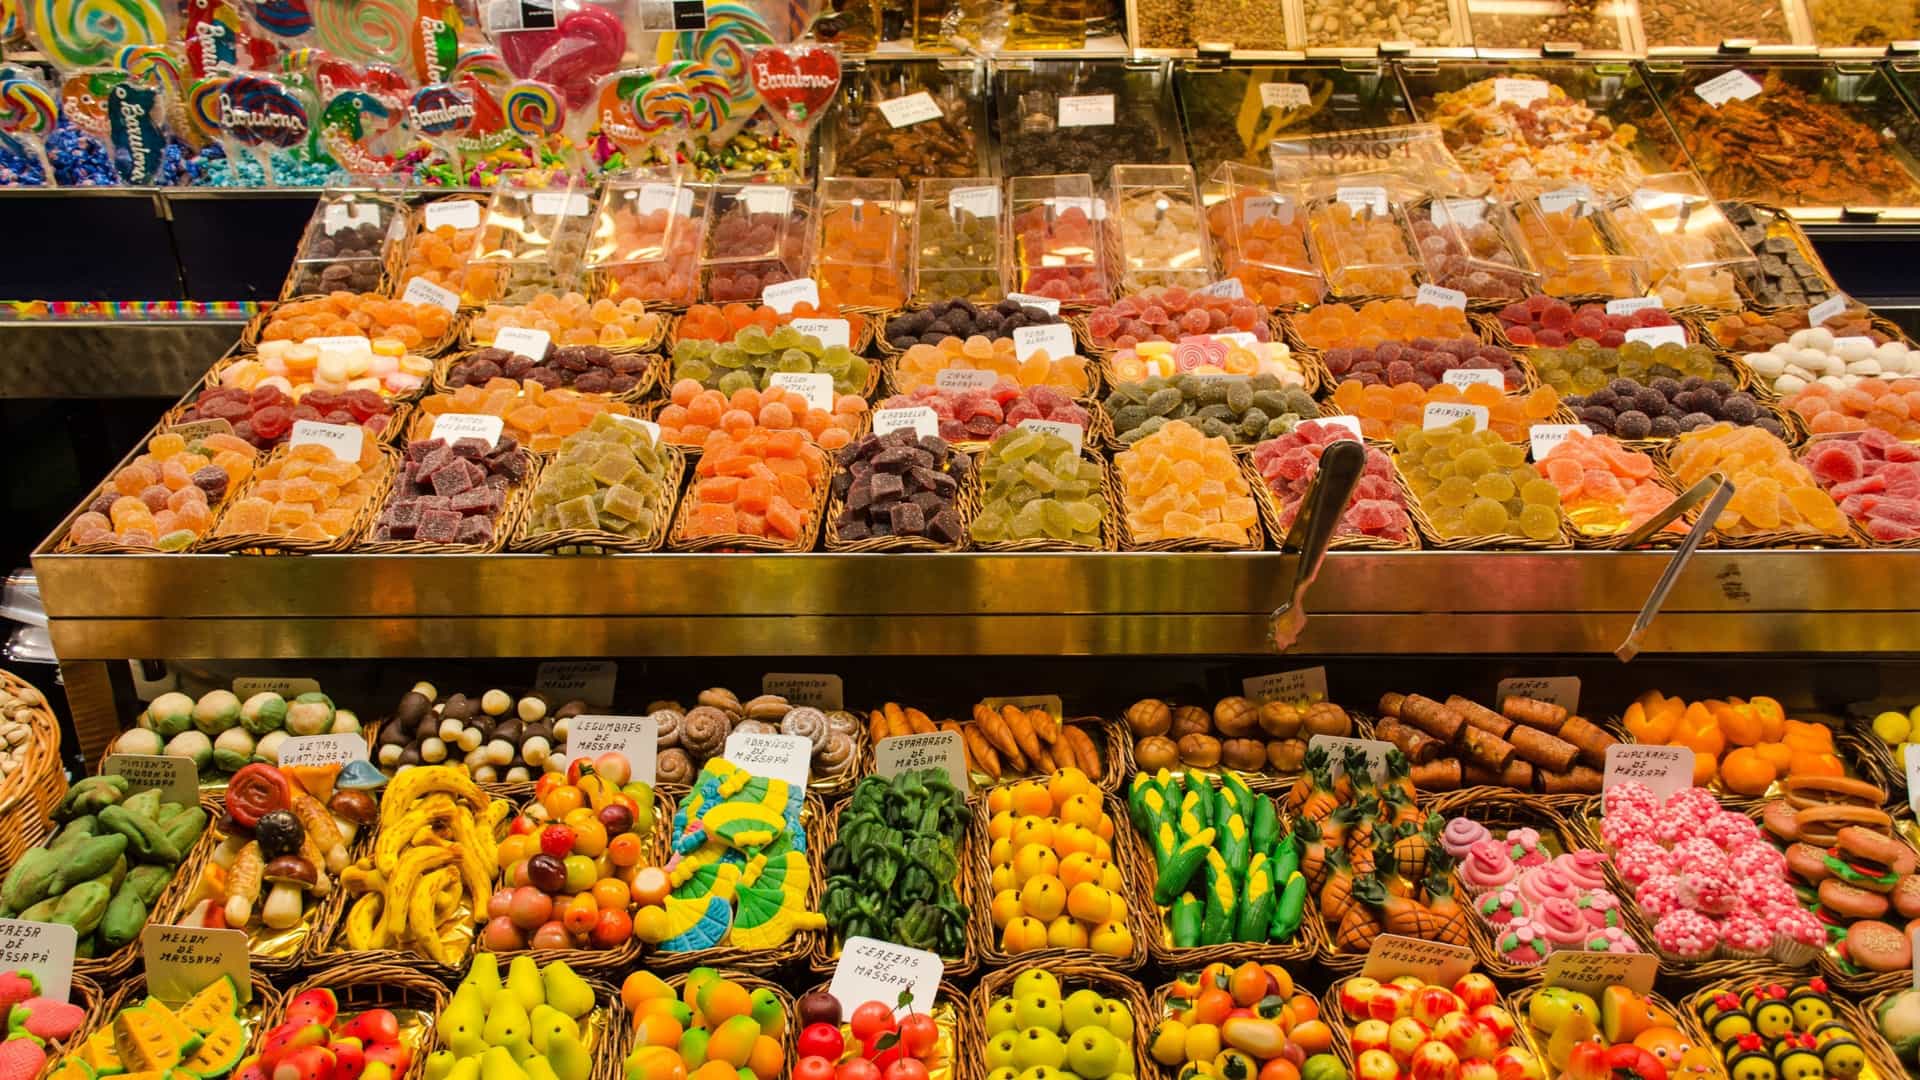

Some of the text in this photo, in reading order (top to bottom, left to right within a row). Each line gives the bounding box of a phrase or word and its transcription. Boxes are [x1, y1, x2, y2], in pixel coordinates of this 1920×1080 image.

[757, 63, 838, 91] Barcelona
[120, 101, 150, 182] Barcelona
[577, 721, 642, 734] LEGUMBRES
[594, 733, 610, 742] DE
[576, 738, 629, 752] MASSAPÀ
[751, 747, 767, 756] DE
[894, 751, 949, 769] MASSAPÀ
[910, 749, 926, 760] DE
[1631, 760, 1649, 769] DE
[5, 938, 25, 949] DE
[176, 944, 195, 955] DE
[0, 948, 51, 964] ASSAPÀ
[159, 951, 224, 966] MASSAPÀ
[855, 944, 921, 969] CEREZAS
[872, 961, 894, 973] DE
